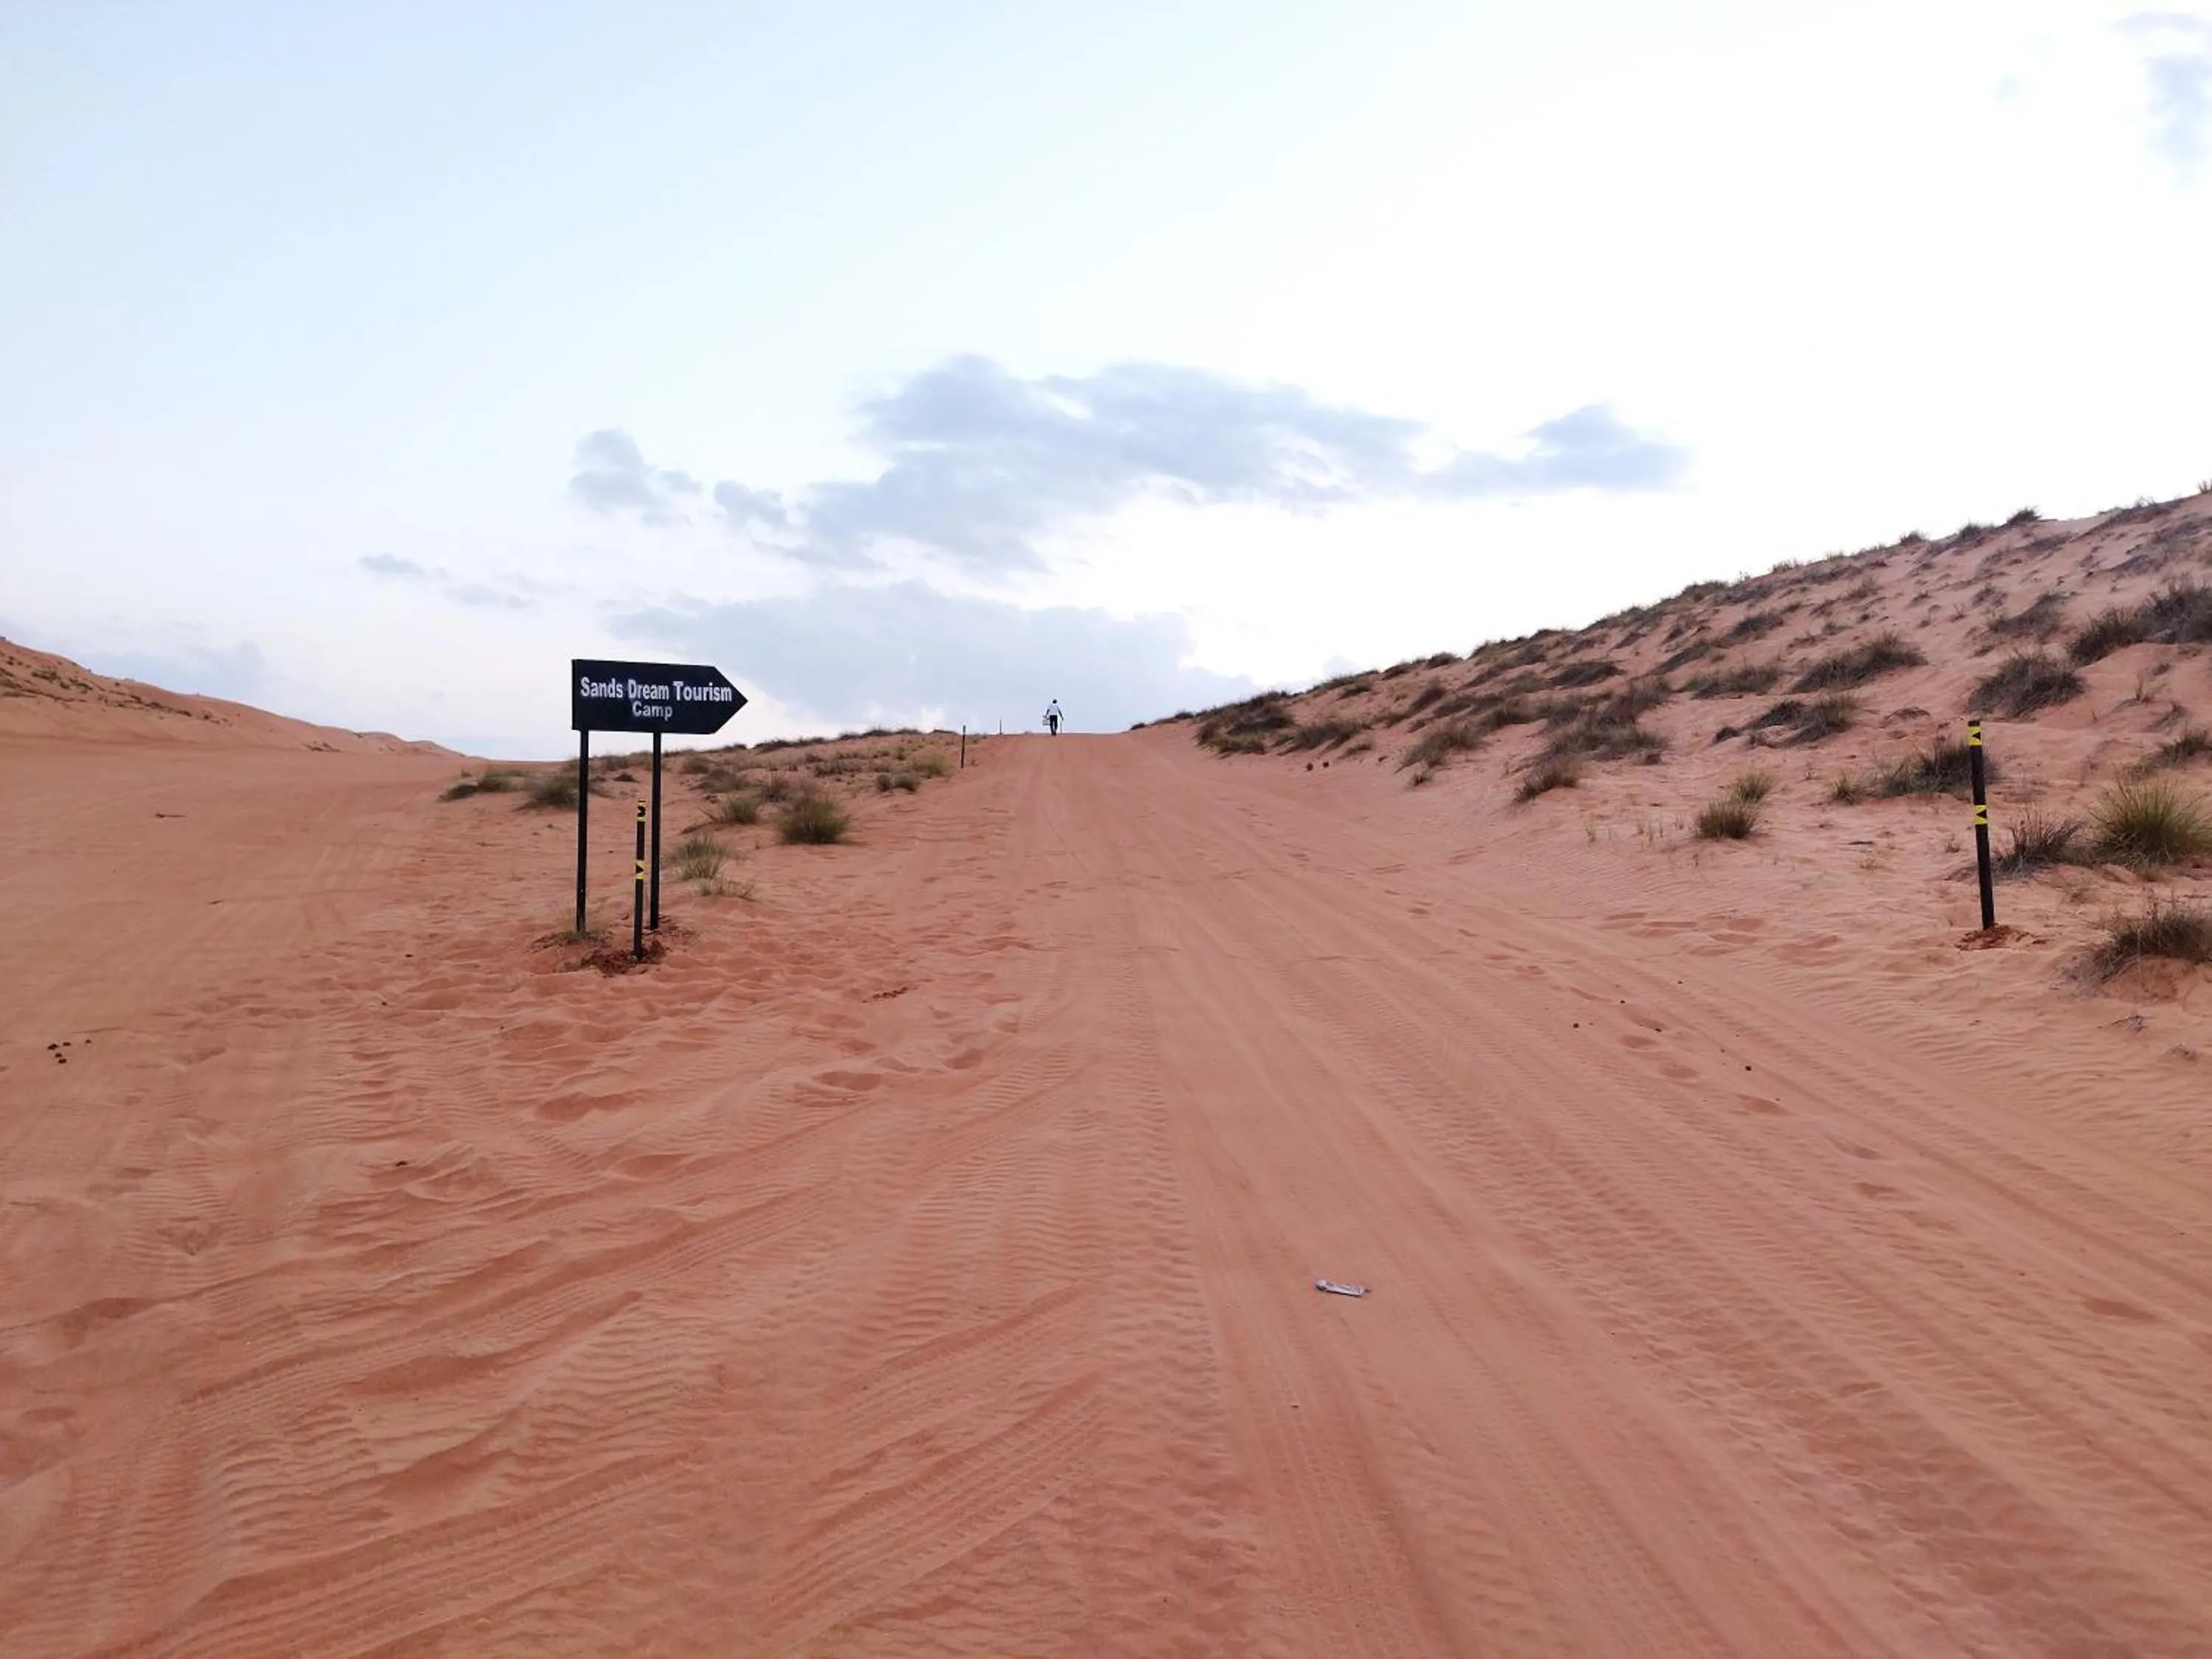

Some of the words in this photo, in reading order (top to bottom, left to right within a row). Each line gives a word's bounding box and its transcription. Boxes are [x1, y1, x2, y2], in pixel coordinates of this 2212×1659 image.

[580, 676, 624, 698] Sands
[627, 678, 669, 700] Dream
[672, 681, 732, 701] Tourism
[633, 701, 672, 720] Camp
